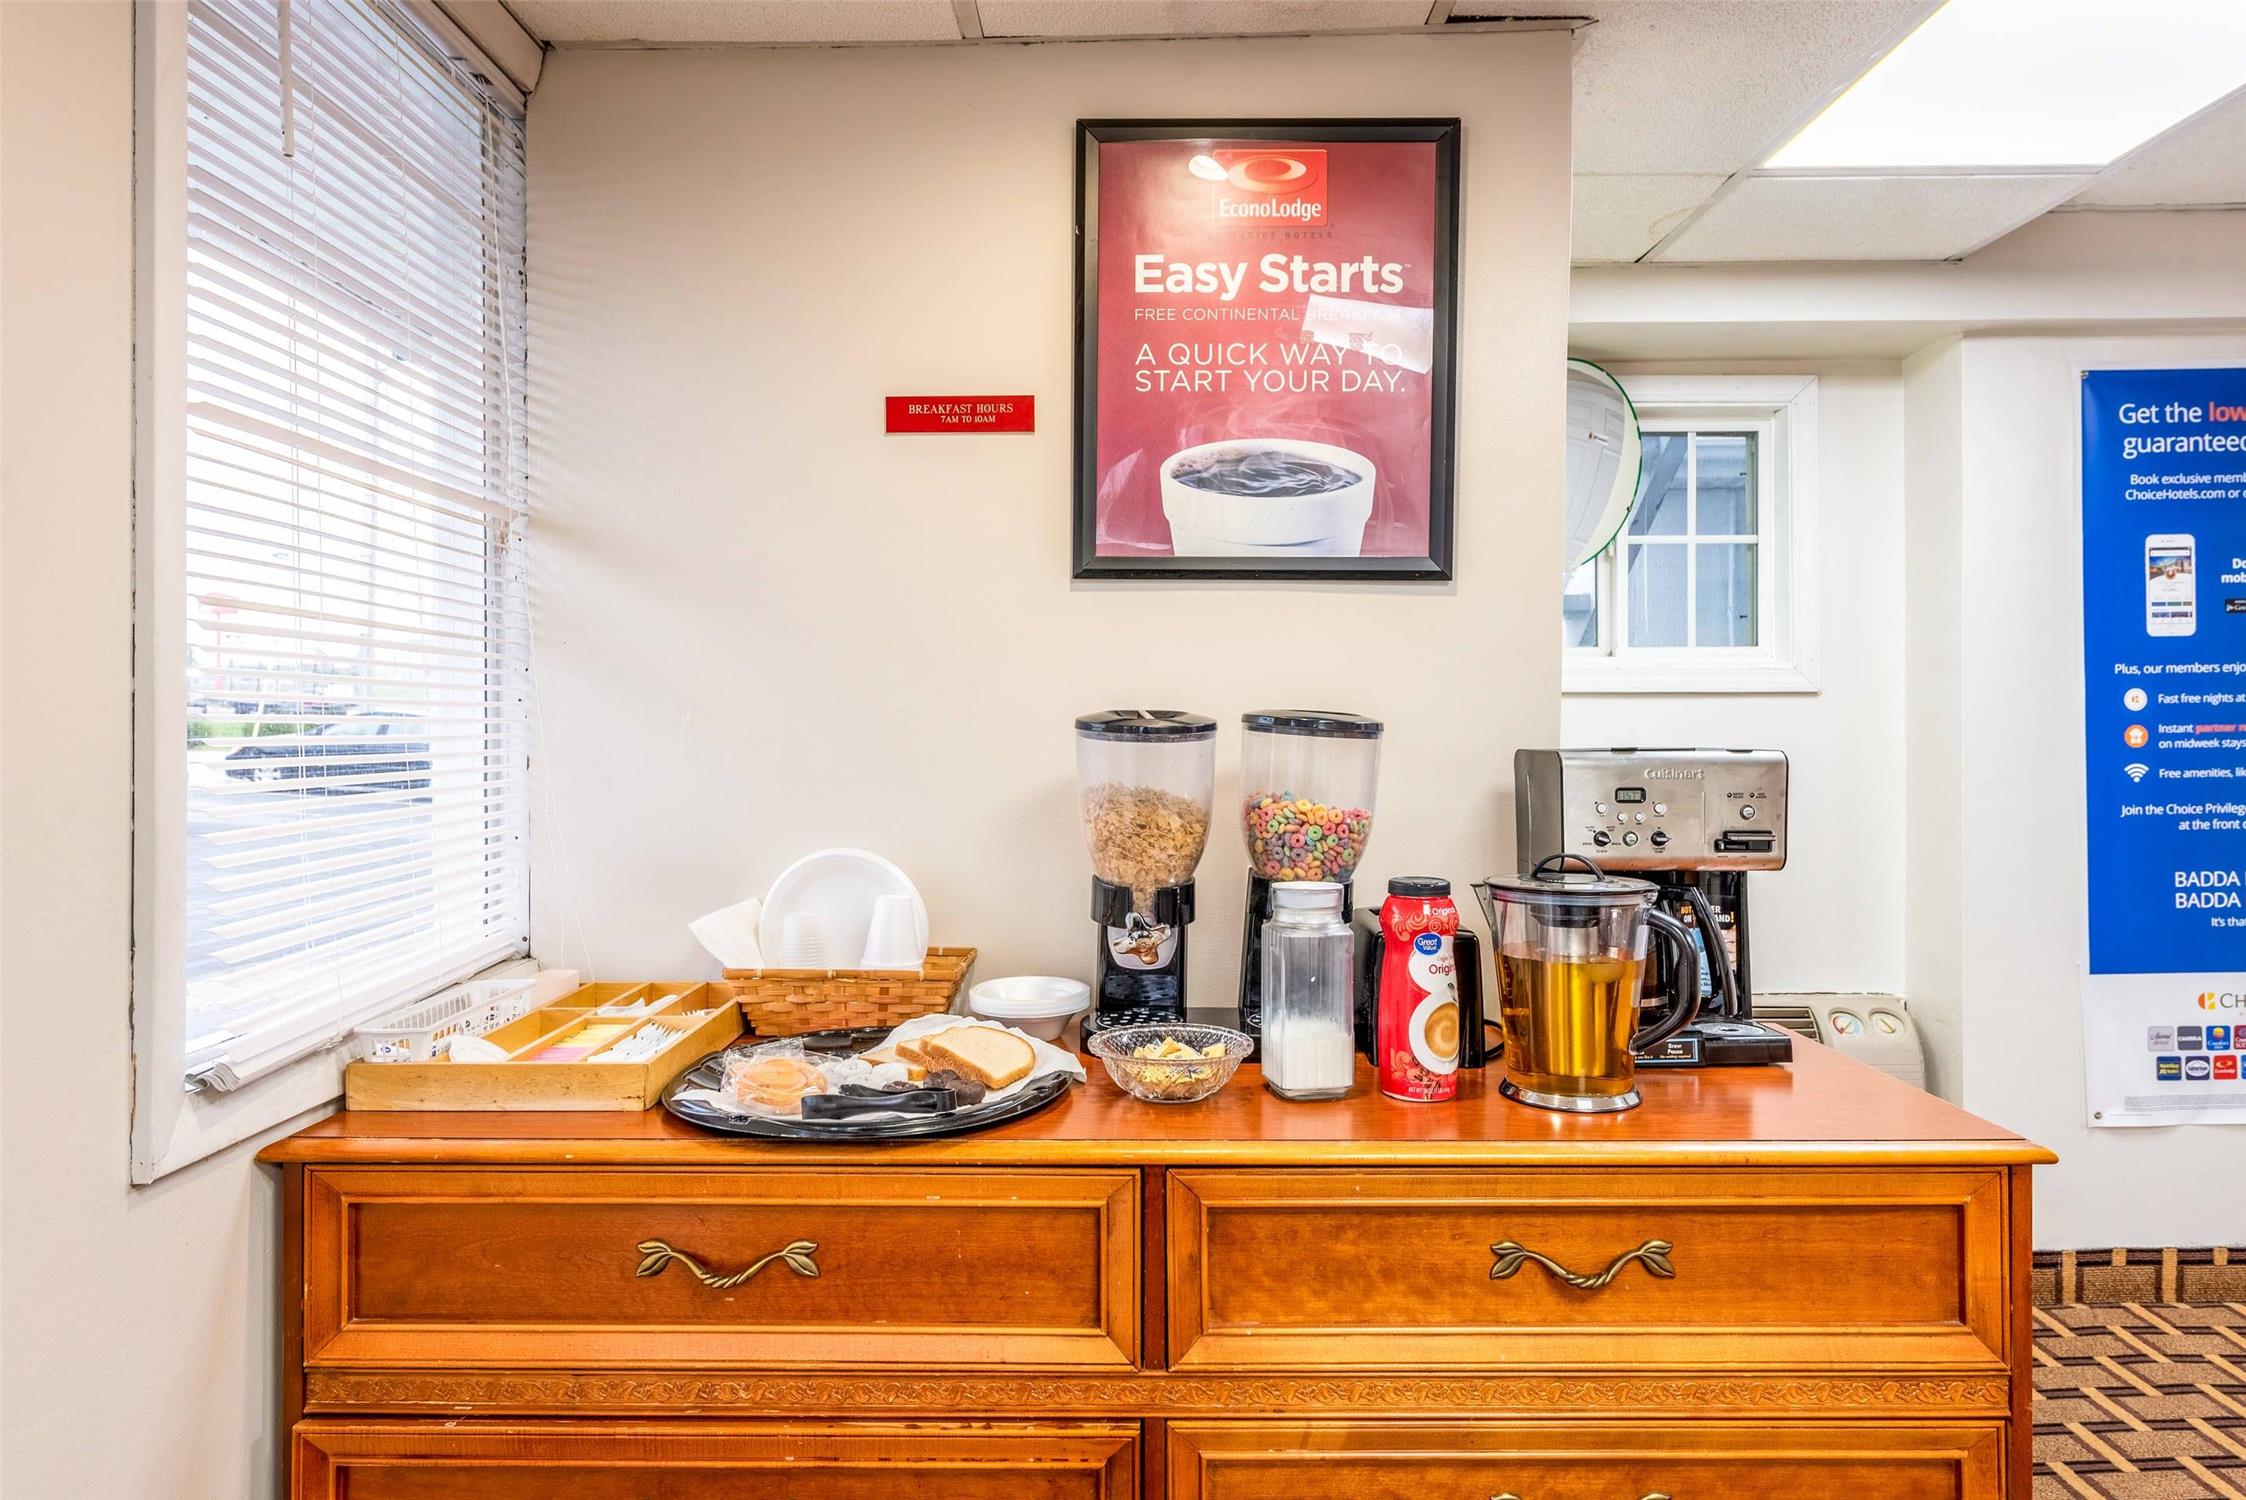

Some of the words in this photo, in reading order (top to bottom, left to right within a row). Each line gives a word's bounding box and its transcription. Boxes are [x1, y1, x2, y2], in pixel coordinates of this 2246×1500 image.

[1220, 198, 1321, 222] EconoLodge
[1134, 254, 1248, 301] Easy
[1134, 308, 1176, 321] FREE
[1182, 308, 1299, 321] CONTINENTAL
[1135, 343, 1156, 366] A
[1168, 342, 1267, 366] QUICK
[1280, 342, 1348, 366] WAY
[1364, 343, 1402, 366] TO
[1135, 370, 1232, 393] START
[1243, 370, 1329, 392] YOUR
[1342, 370, 1405, 392] DAY.
[908, 403, 972, 414] BREAKFAST
[976, 403, 1013, 413] HOURS
[2118, 403, 2159, 424] Get
[2164, 401, 2202, 423] the
[940, 415, 959, 423] 7AM
[962, 415, 972, 423] TO
[2130, 473, 2159, 485] Book
[2161, 472, 2212, 485] exclusive
[2125, 488, 2225, 500] ChoiceHotels.com
[2227, 489, 2241, 499] or
[2114, 663, 2141, 675] Plus,
[2143, 664, 2163, 674] our
[2165, 662, 2220, 673] members
[2158, 693, 2179, 704] Fast
[2181, 693, 2201, 704] free
[2203, 692, 2234, 706] nights
[2235, 693, 2246, 703] at
[2158, 724, 2193, 734] Instant
[2195, 724, 2236, 735] partner
[2158, 740, 2172, 749] on
[2174, 738, 2220, 748] midweek
[2221, 739, 2246, 750] stays
[1643, 767, 1705, 780] Cuisinart
[2159, 768, 2181, 778] Free
[2183, 767, 2234, 778] amenities,
[2120, 804, 2143, 818] Join
[2145, 804, 2164, 815] the
[2166, 803, 2204, 815] Choice
[2178, 820, 2190, 830] at
[2191, 819, 2211, 830] the
[2212, 818, 2240, 830] front
[2175, 870, 2241, 887] BADDA
[2175, 892, 2242, 908] BADDA
[1680, 905, 1692, 914] HOT
[2211, 916, 2226, 927] It's
[1417, 937, 1437, 946] Great
